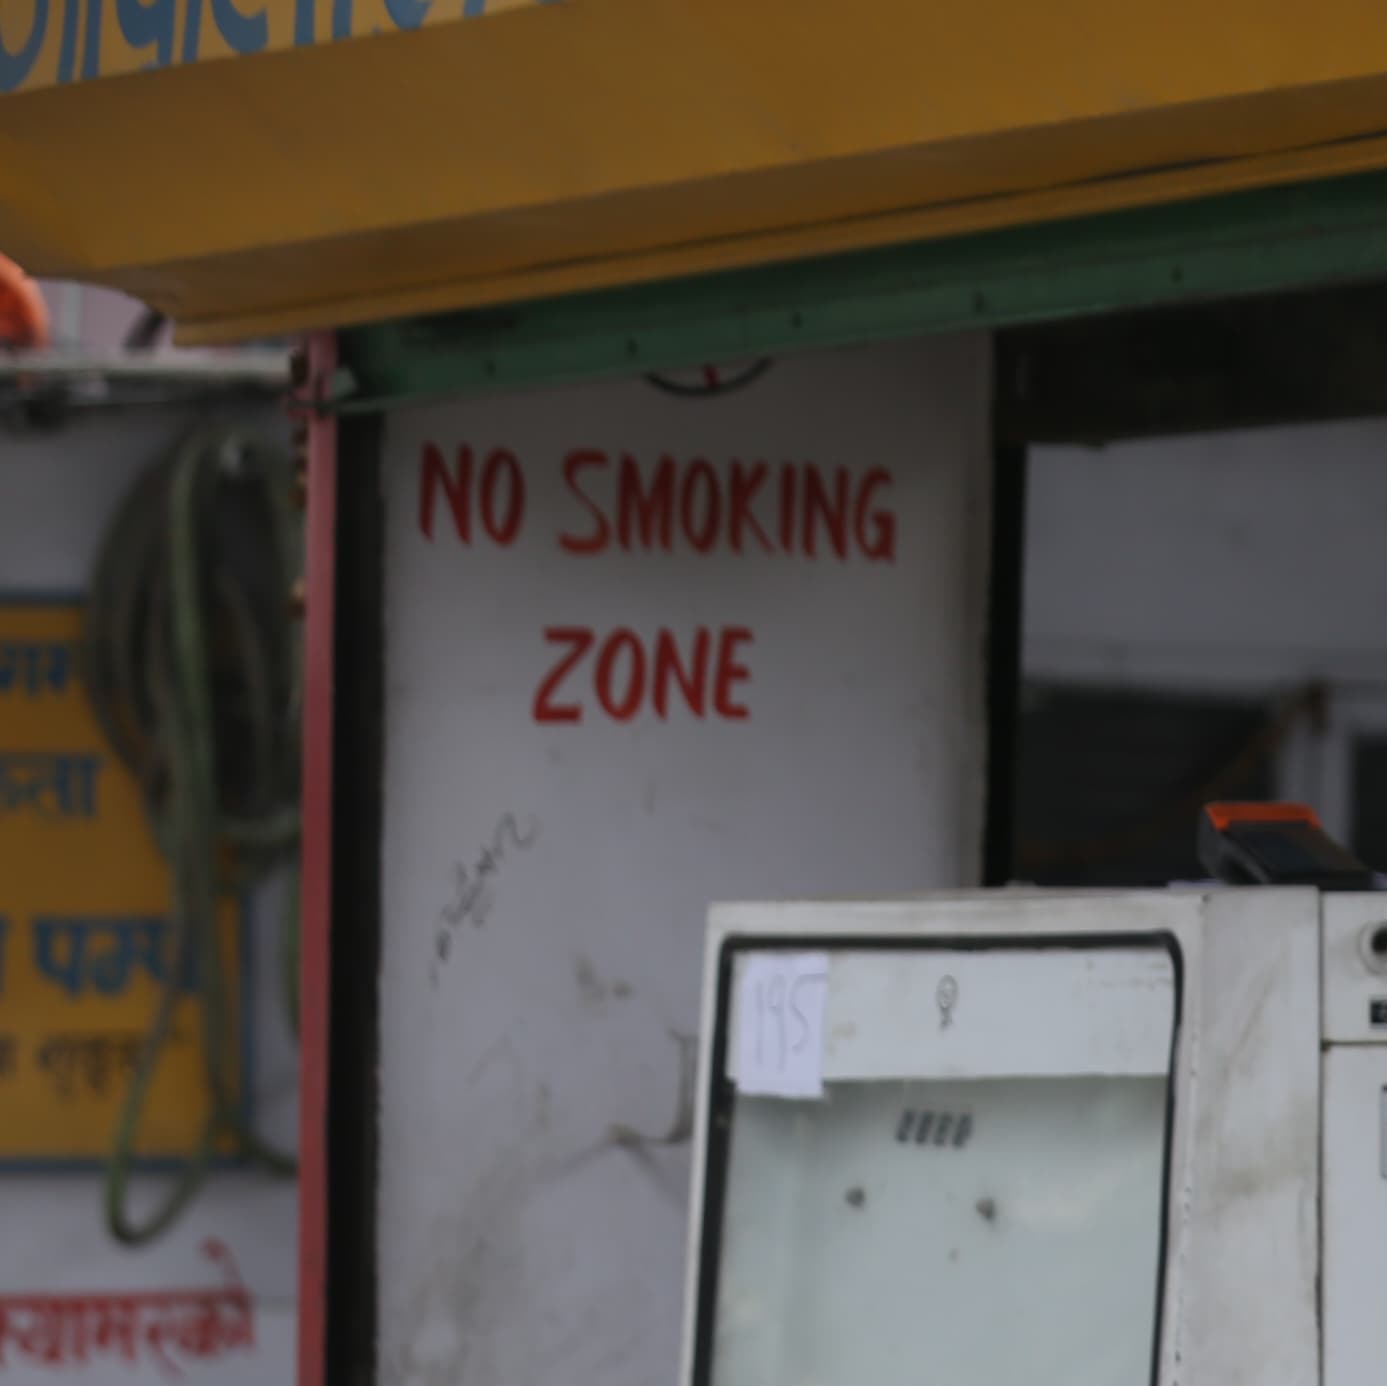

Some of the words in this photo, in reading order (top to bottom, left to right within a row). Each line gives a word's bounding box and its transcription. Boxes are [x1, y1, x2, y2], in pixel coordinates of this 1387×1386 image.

[418, 442, 526, 548] NO
[557, 449, 897, 563] SMOKING
[531, 625, 754, 725] ZONE
